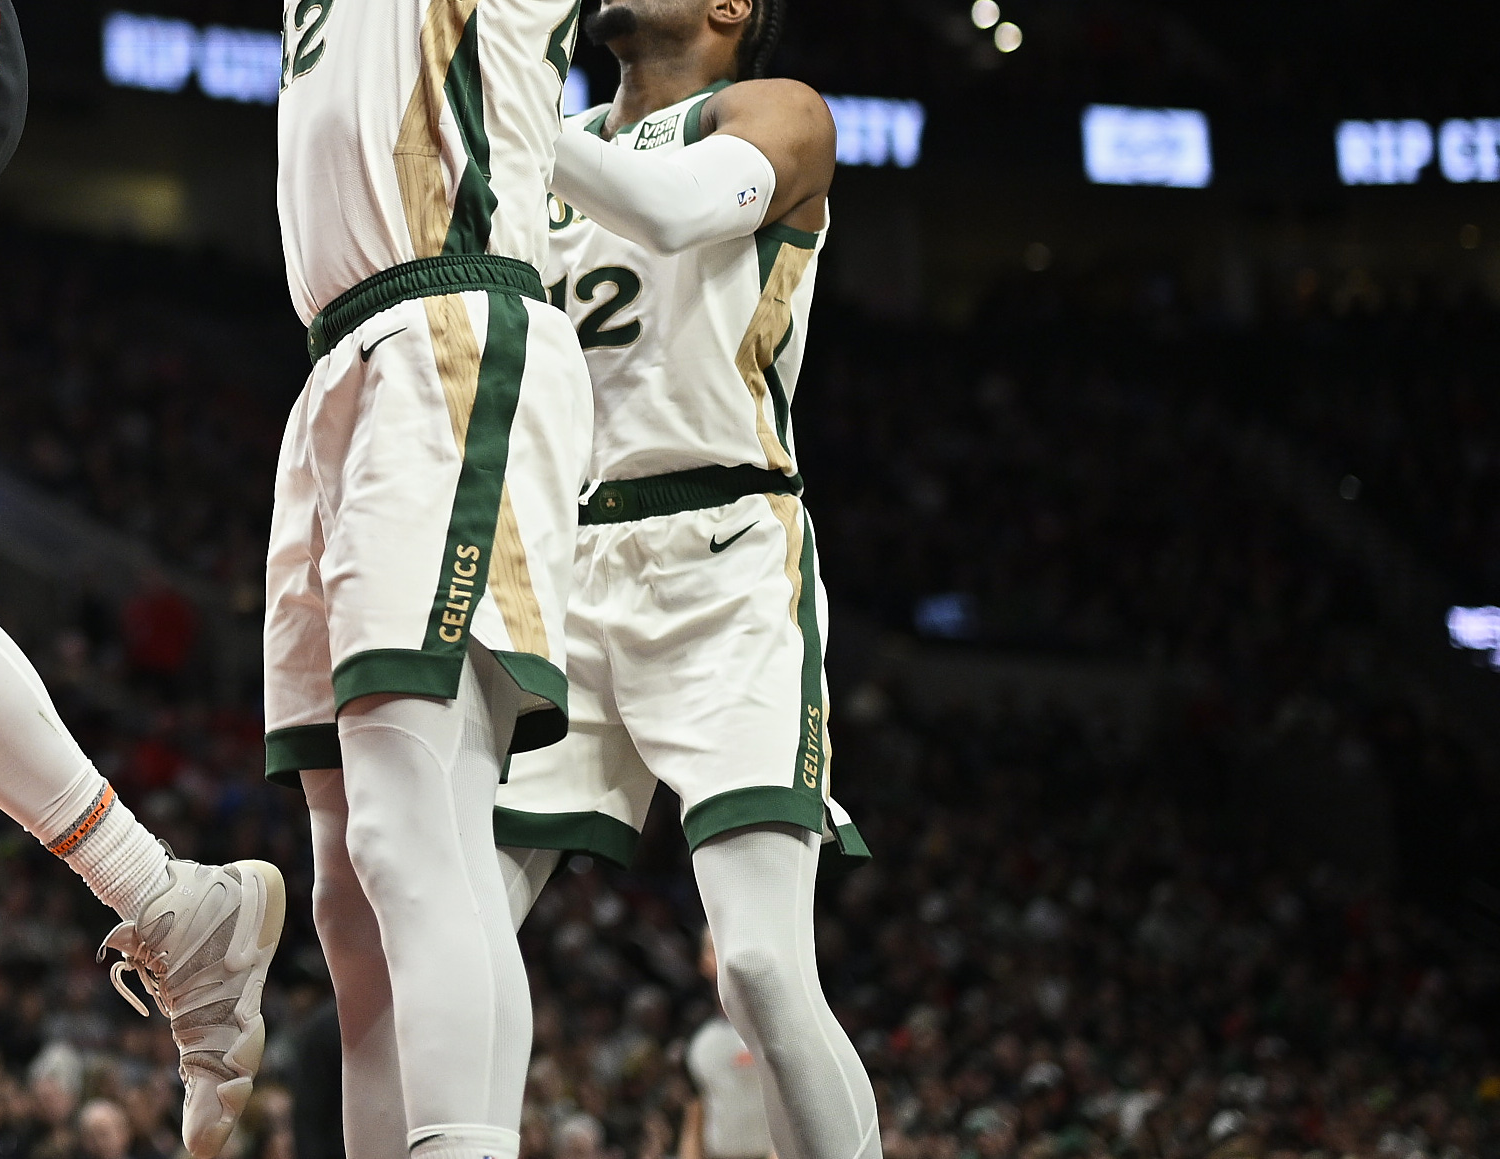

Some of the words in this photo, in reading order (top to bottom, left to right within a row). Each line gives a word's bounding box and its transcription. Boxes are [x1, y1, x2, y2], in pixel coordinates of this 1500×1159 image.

[636, 129, 675, 150] PRINT
[643, 115, 678, 138] VISTA
[1334, 119, 1434, 186] RIP
[438, 543, 481, 644] CELTICS
[802, 703, 821, 789] CELTICS
